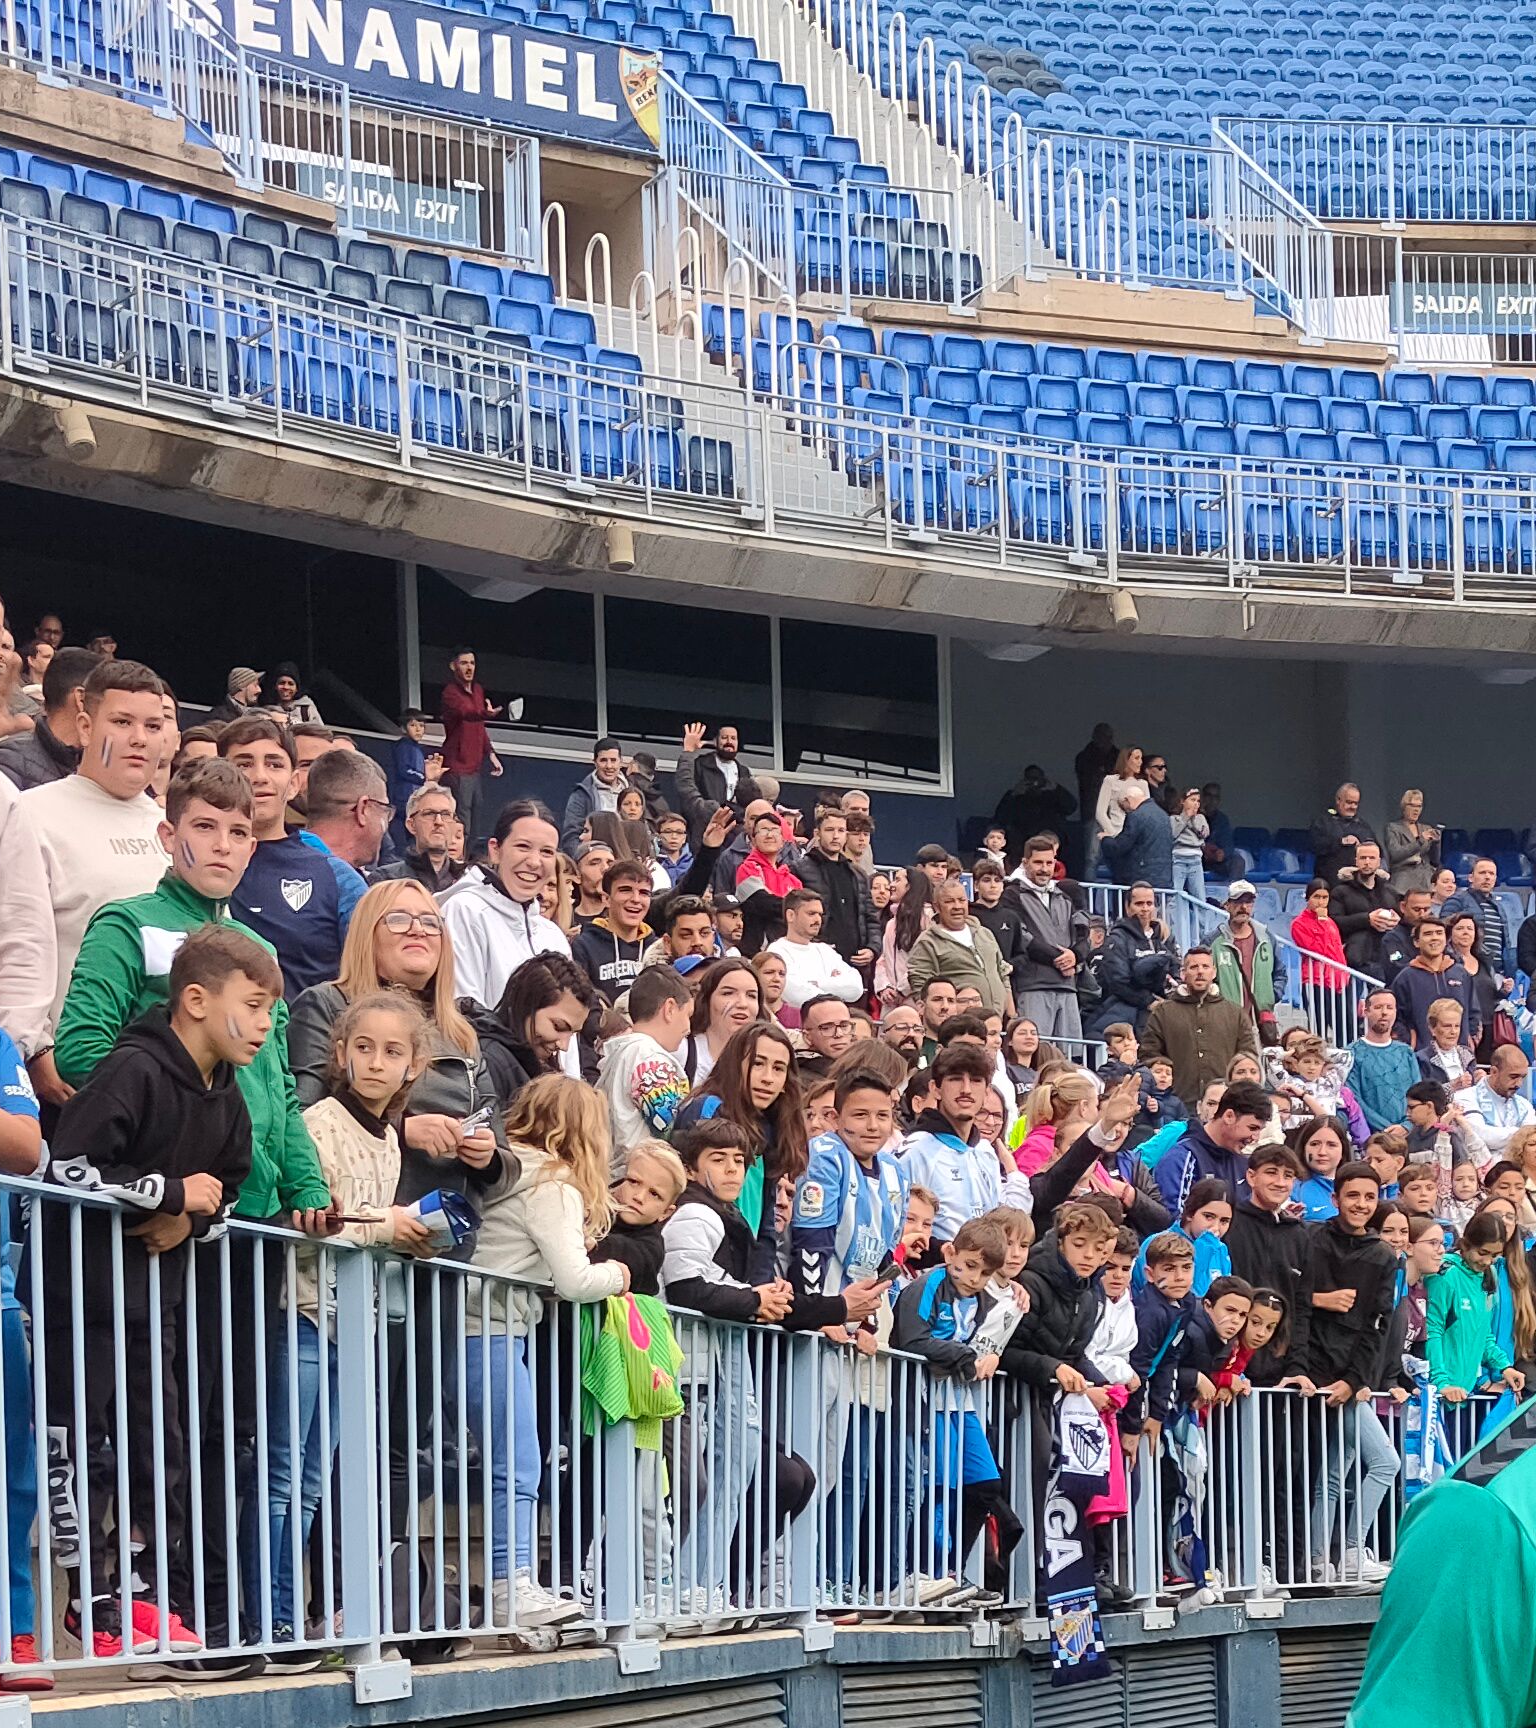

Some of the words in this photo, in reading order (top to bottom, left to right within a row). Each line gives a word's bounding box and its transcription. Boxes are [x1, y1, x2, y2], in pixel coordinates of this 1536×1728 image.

[324, 181, 401, 214] SALIDA
[415, 198, 460, 224] EXIT
[1412, 294, 1483, 315] SALIDA
[109, 837, 158, 856] INSPI
